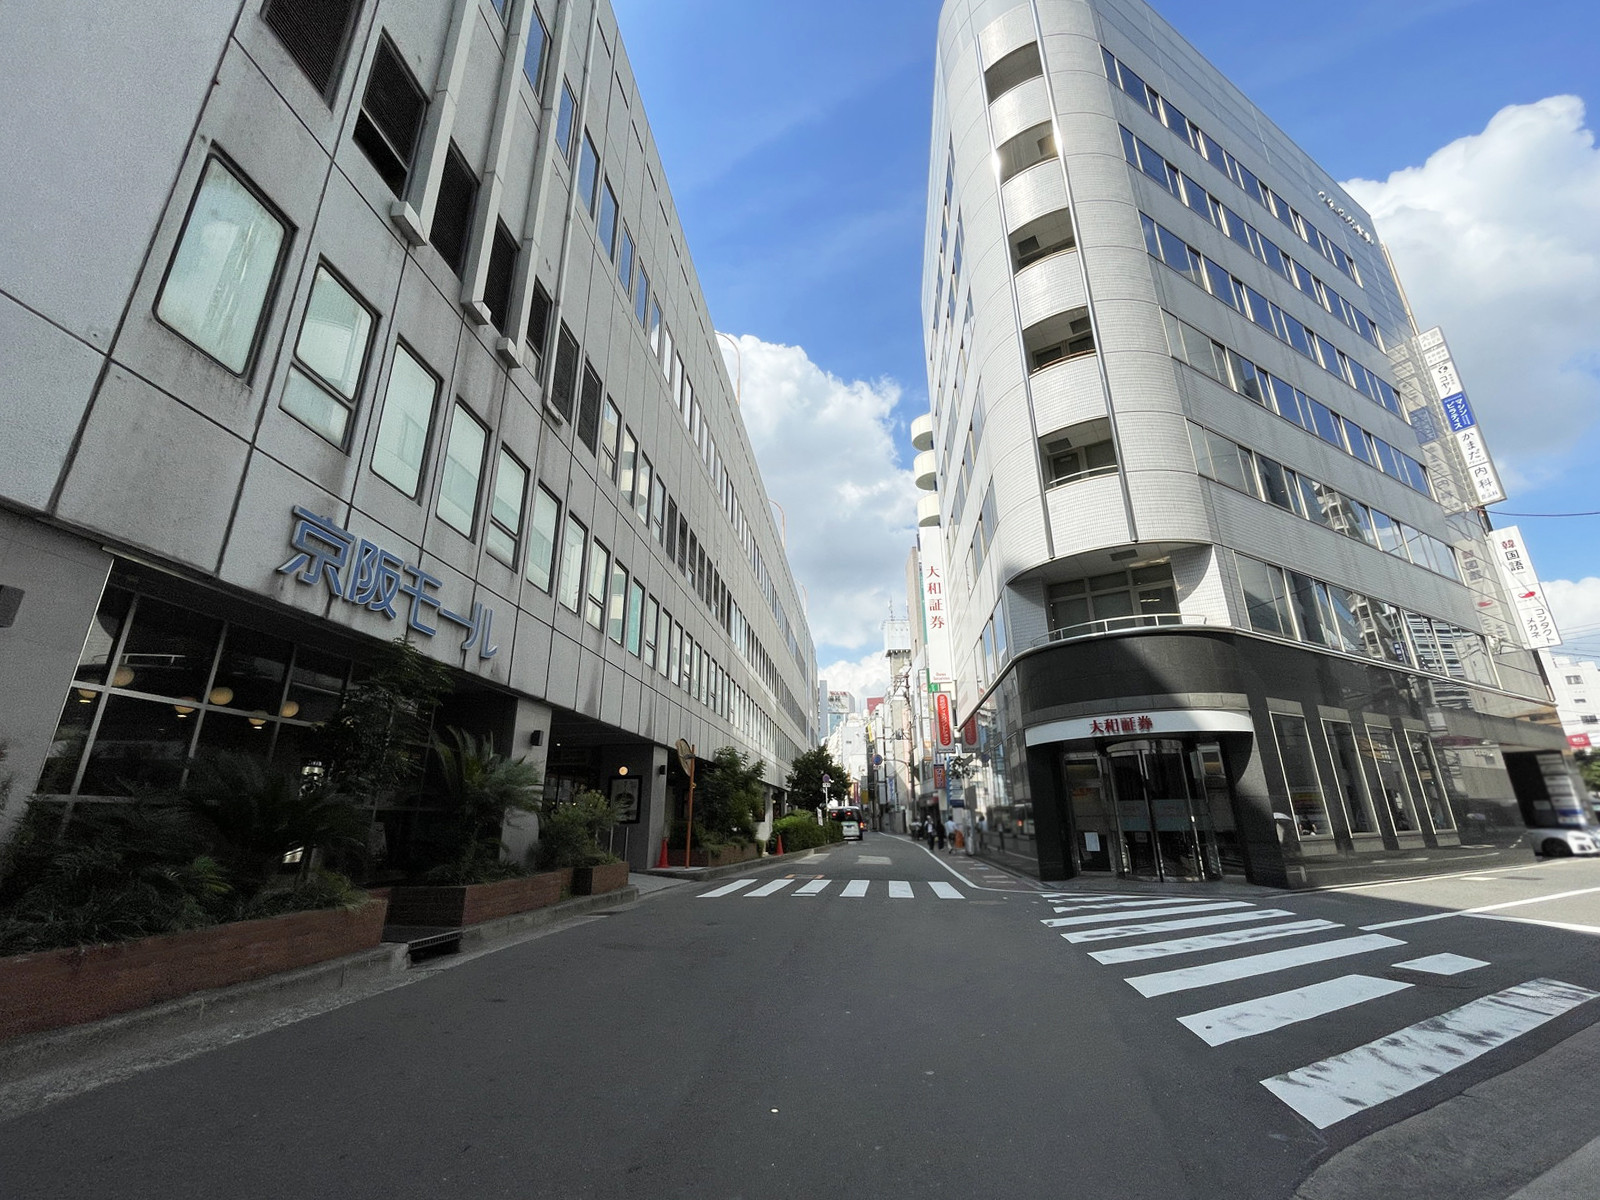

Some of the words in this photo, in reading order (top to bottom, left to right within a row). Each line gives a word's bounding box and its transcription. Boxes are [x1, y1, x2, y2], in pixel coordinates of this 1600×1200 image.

[1462, 432, 1481, 460] かまだ
[1474, 466, 1494, 489] 内科
[1501, 539, 1524, 572] 韓国語
[276, 504, 498, 659] 京阪モール
[926, 565, 945, 629] 大和証券
[1527, 617, 1541, 639] メガネ
[1535, 608, 1555, 644] コンタクト
[1089, 715, 1153, 735] 大和証券
